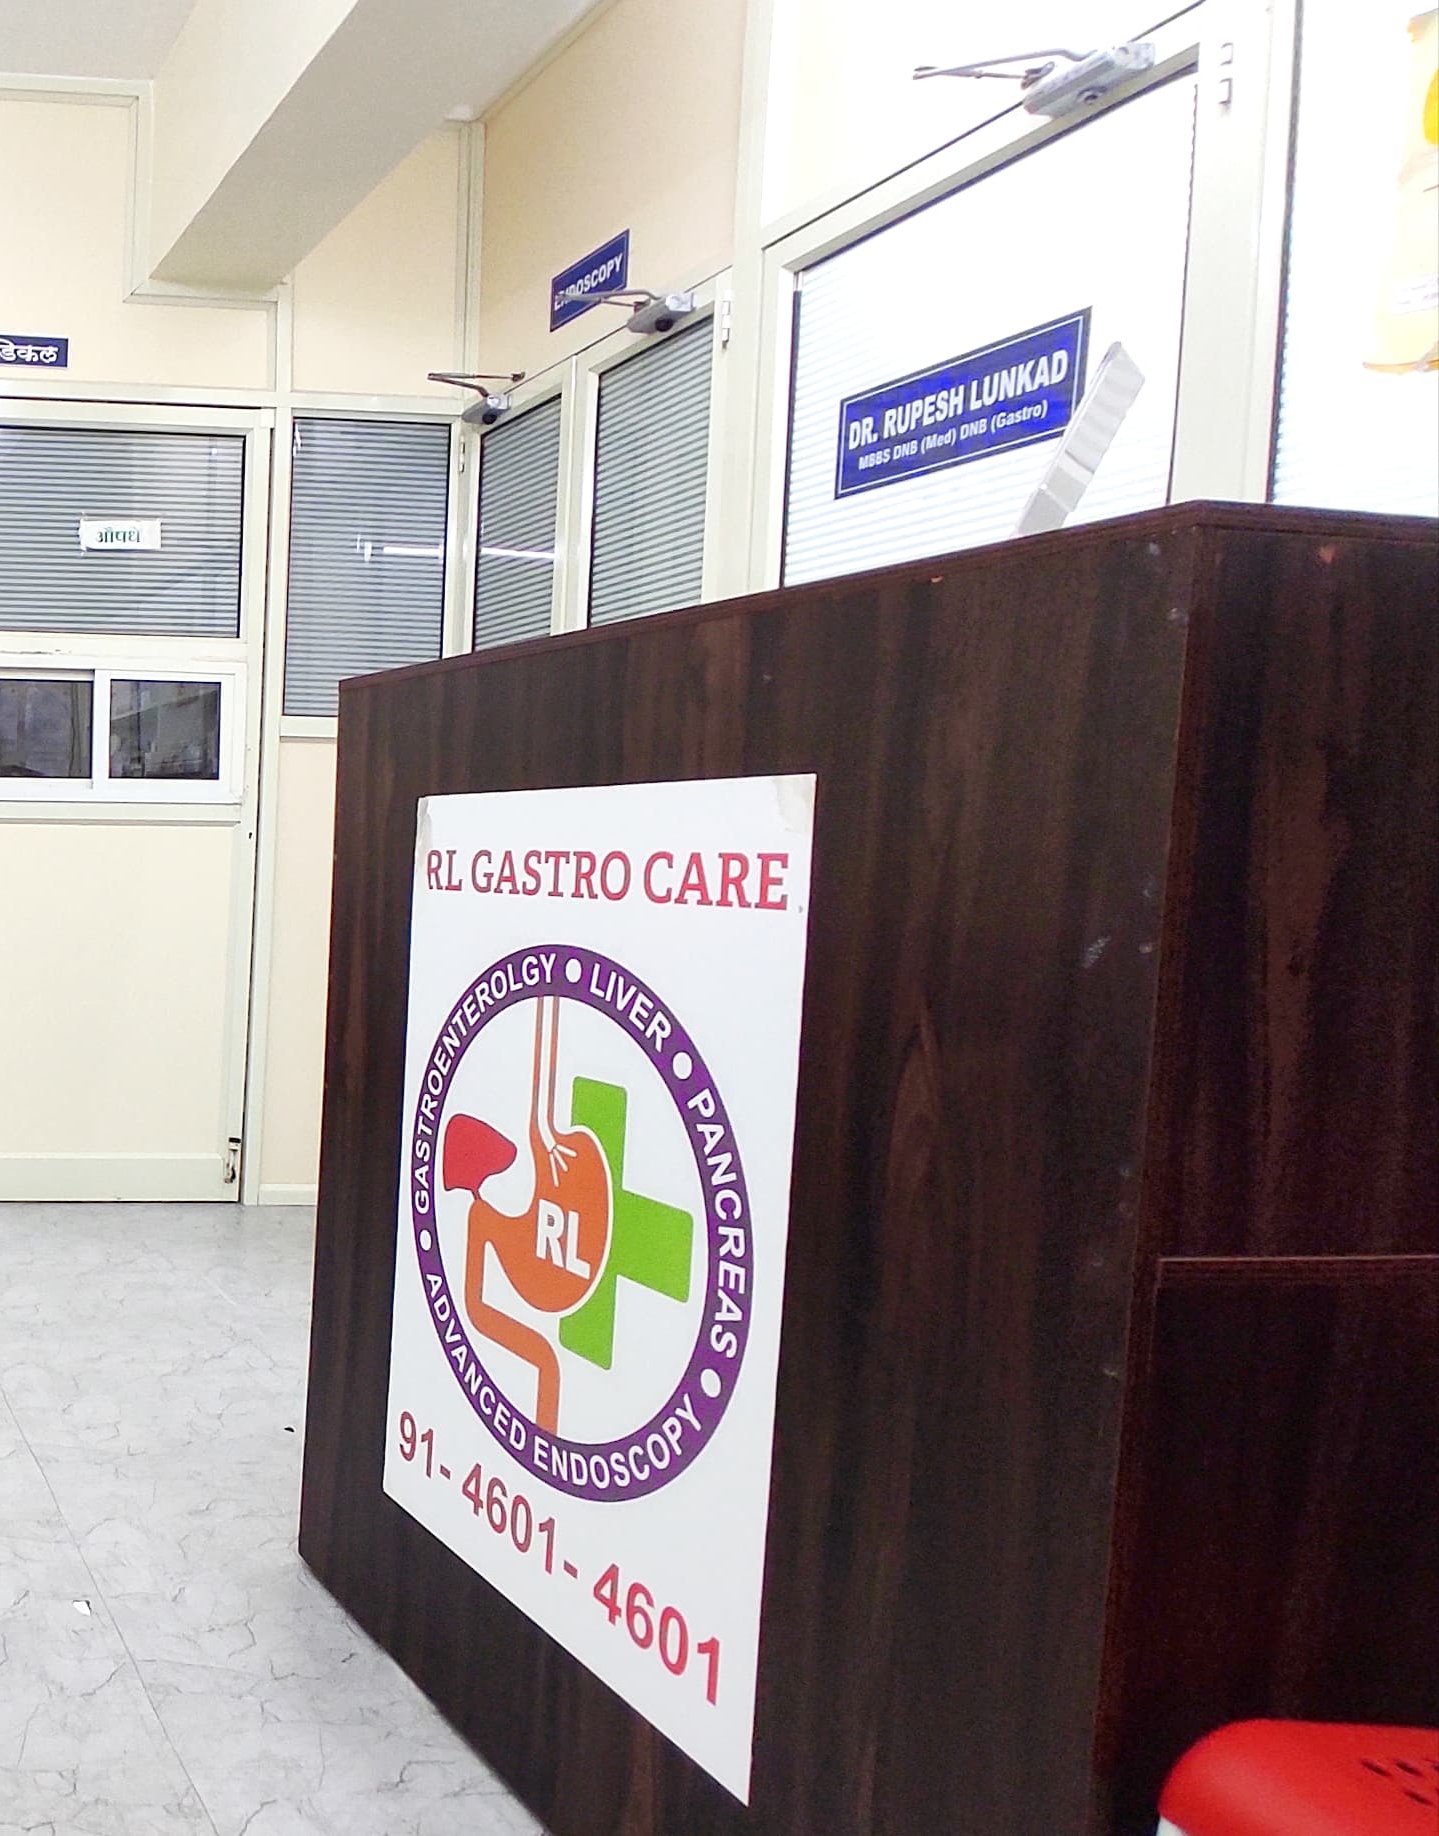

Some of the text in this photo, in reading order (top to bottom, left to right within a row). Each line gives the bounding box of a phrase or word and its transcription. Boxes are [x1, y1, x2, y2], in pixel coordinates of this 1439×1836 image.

[848, 350, 1068, 450] DR. RUPESH LUNKAD
[858, 399, 1048, 470] MBBS DNB (Med) DNB (Gastro)
[428, 849, 789, 911] RL GASTRO CARE
[415, 952, 747, 1360] GASTROENTEROLGY LIVER PANCREAS
[536, 1198, 591, 1281] RL
[426, 1271, 703, 1490] ADVANCED ENDOSCOPY
[592, 1564, 721, 1706] 4601
